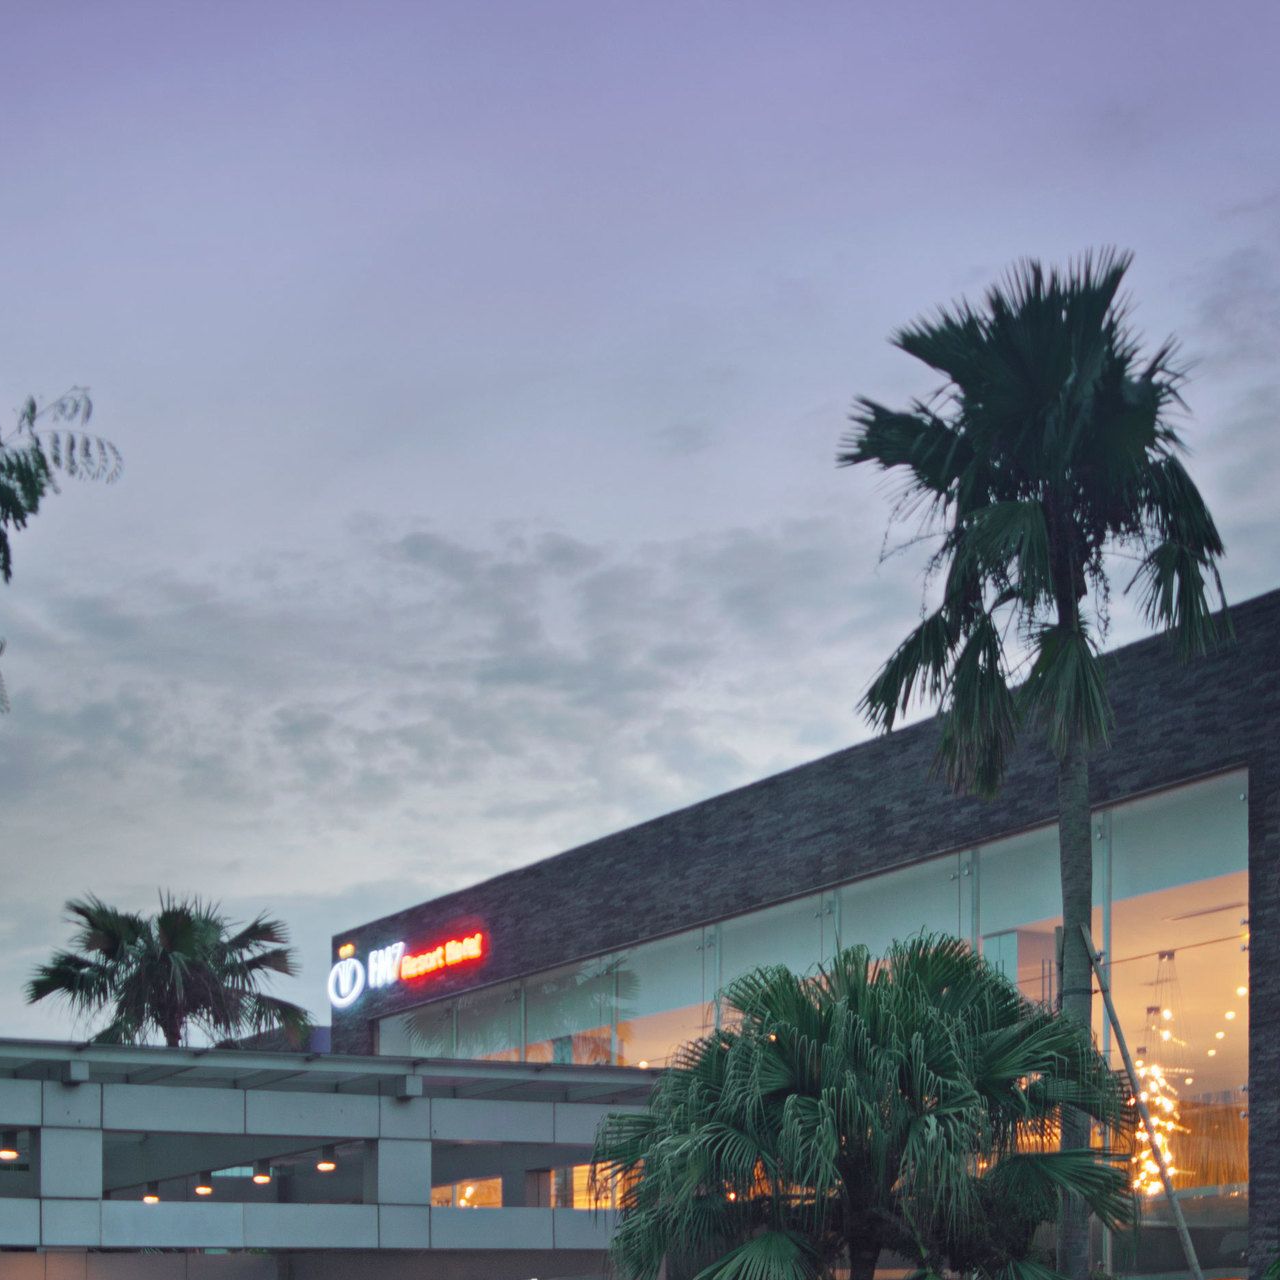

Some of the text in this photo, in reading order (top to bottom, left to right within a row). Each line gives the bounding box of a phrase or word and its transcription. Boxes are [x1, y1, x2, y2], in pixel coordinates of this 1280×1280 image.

[368, 933, 483, 988] FM7 Resort Hotel
